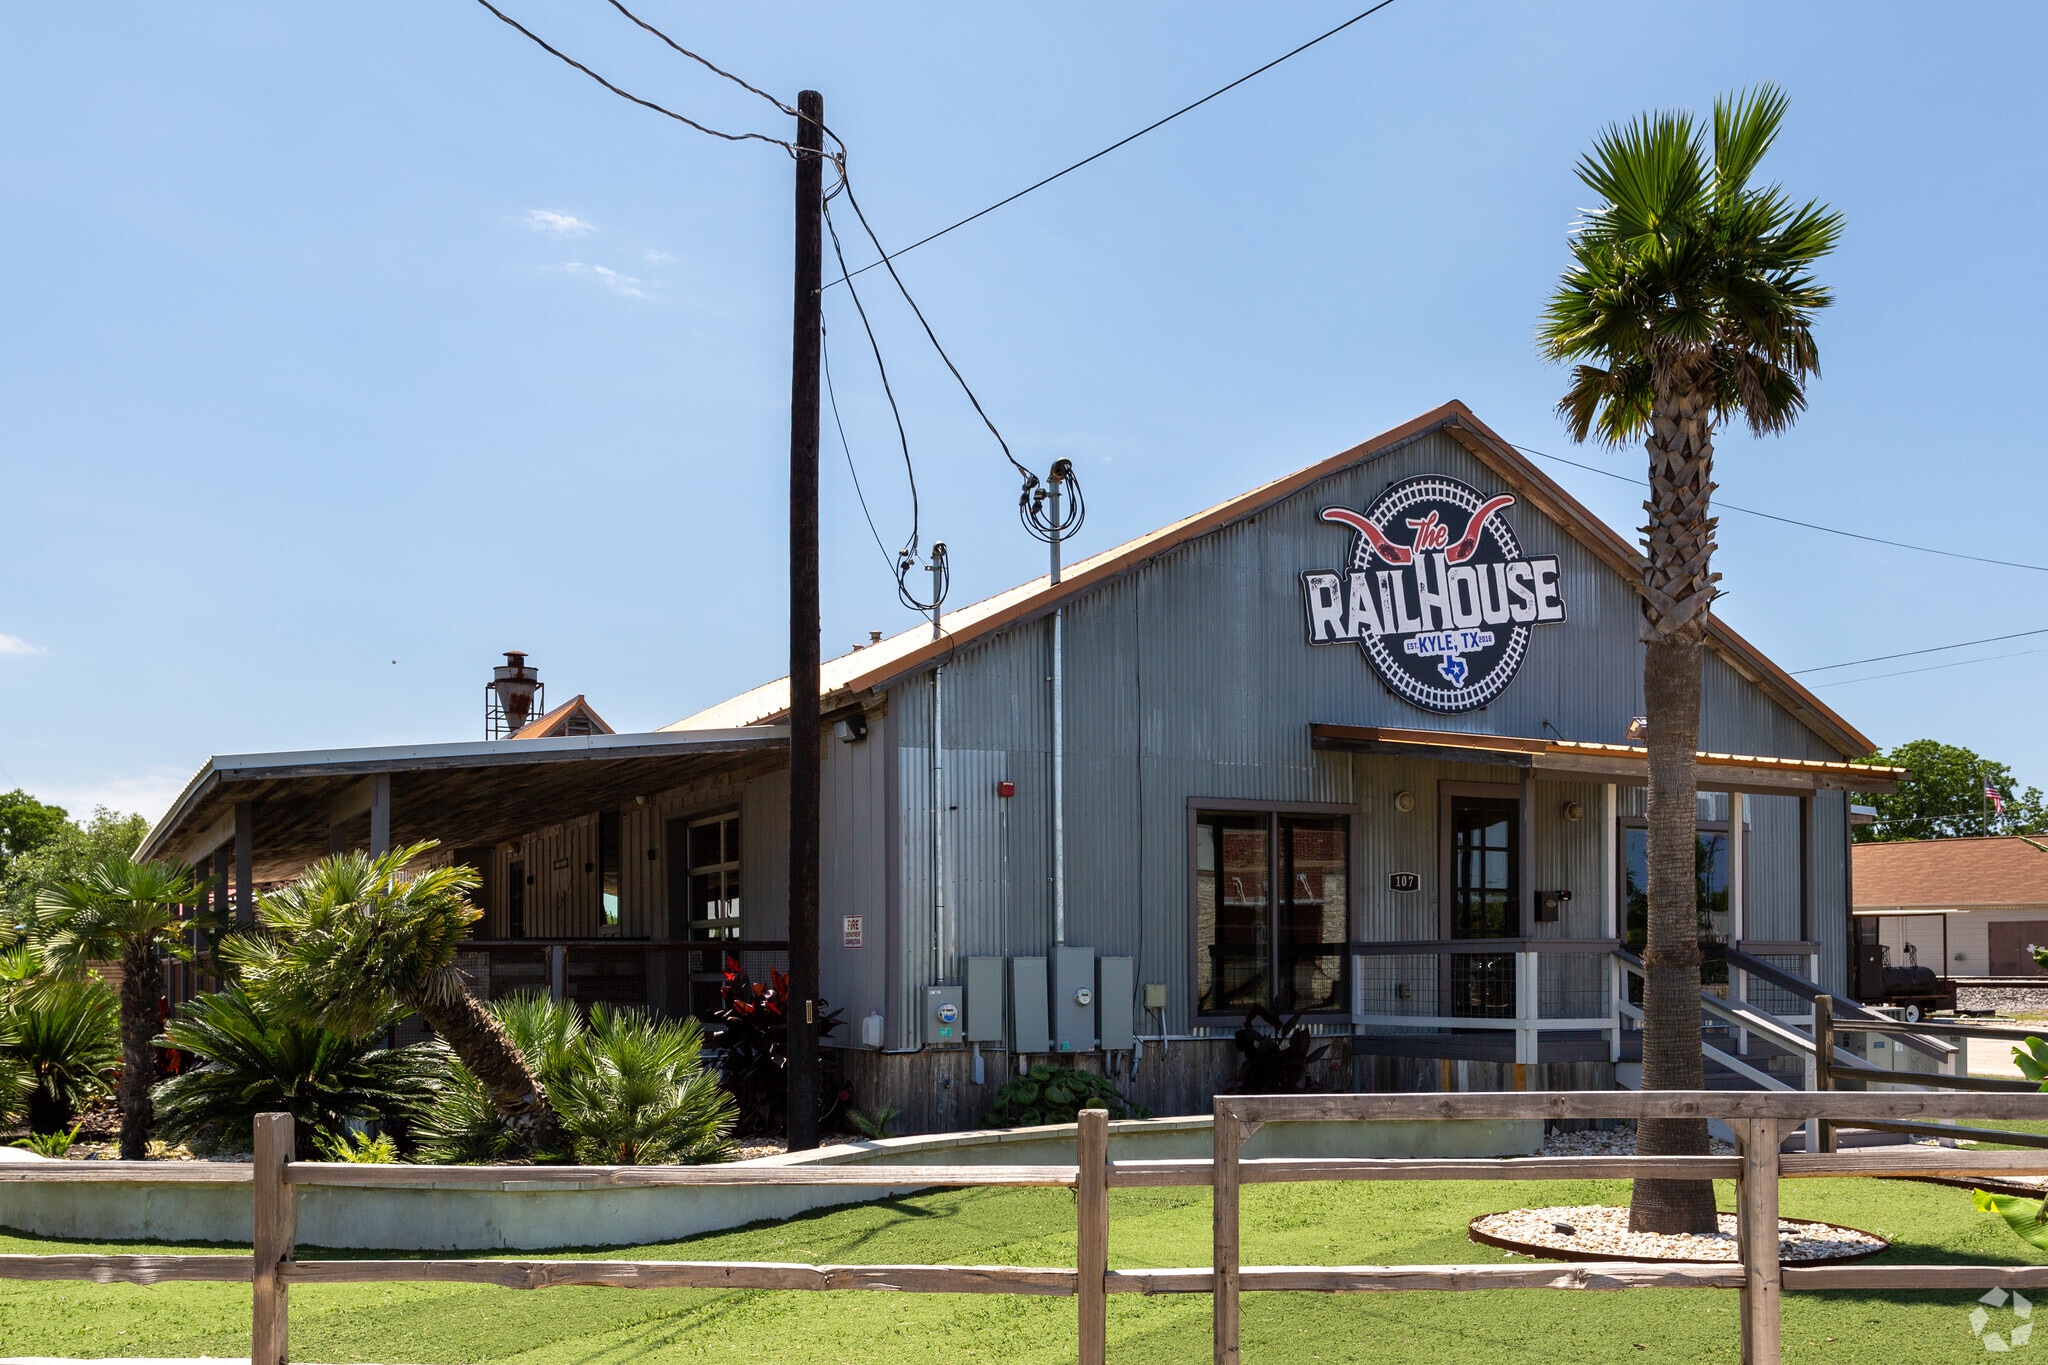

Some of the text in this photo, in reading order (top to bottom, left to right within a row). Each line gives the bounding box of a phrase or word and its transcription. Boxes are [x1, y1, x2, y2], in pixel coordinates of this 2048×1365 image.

[1407, 510, 1448, 553] The
[1306, 553, 1562, 640] RAILHOUSE
[1406, 642, 1419, 651] EST.
[1418, 634, 1458, 653] KYLE,
[1460, 631, 1480, 649] TX
[1395, 875, 1414, 888] 107
[847, 919, 859, 930] FIRE
